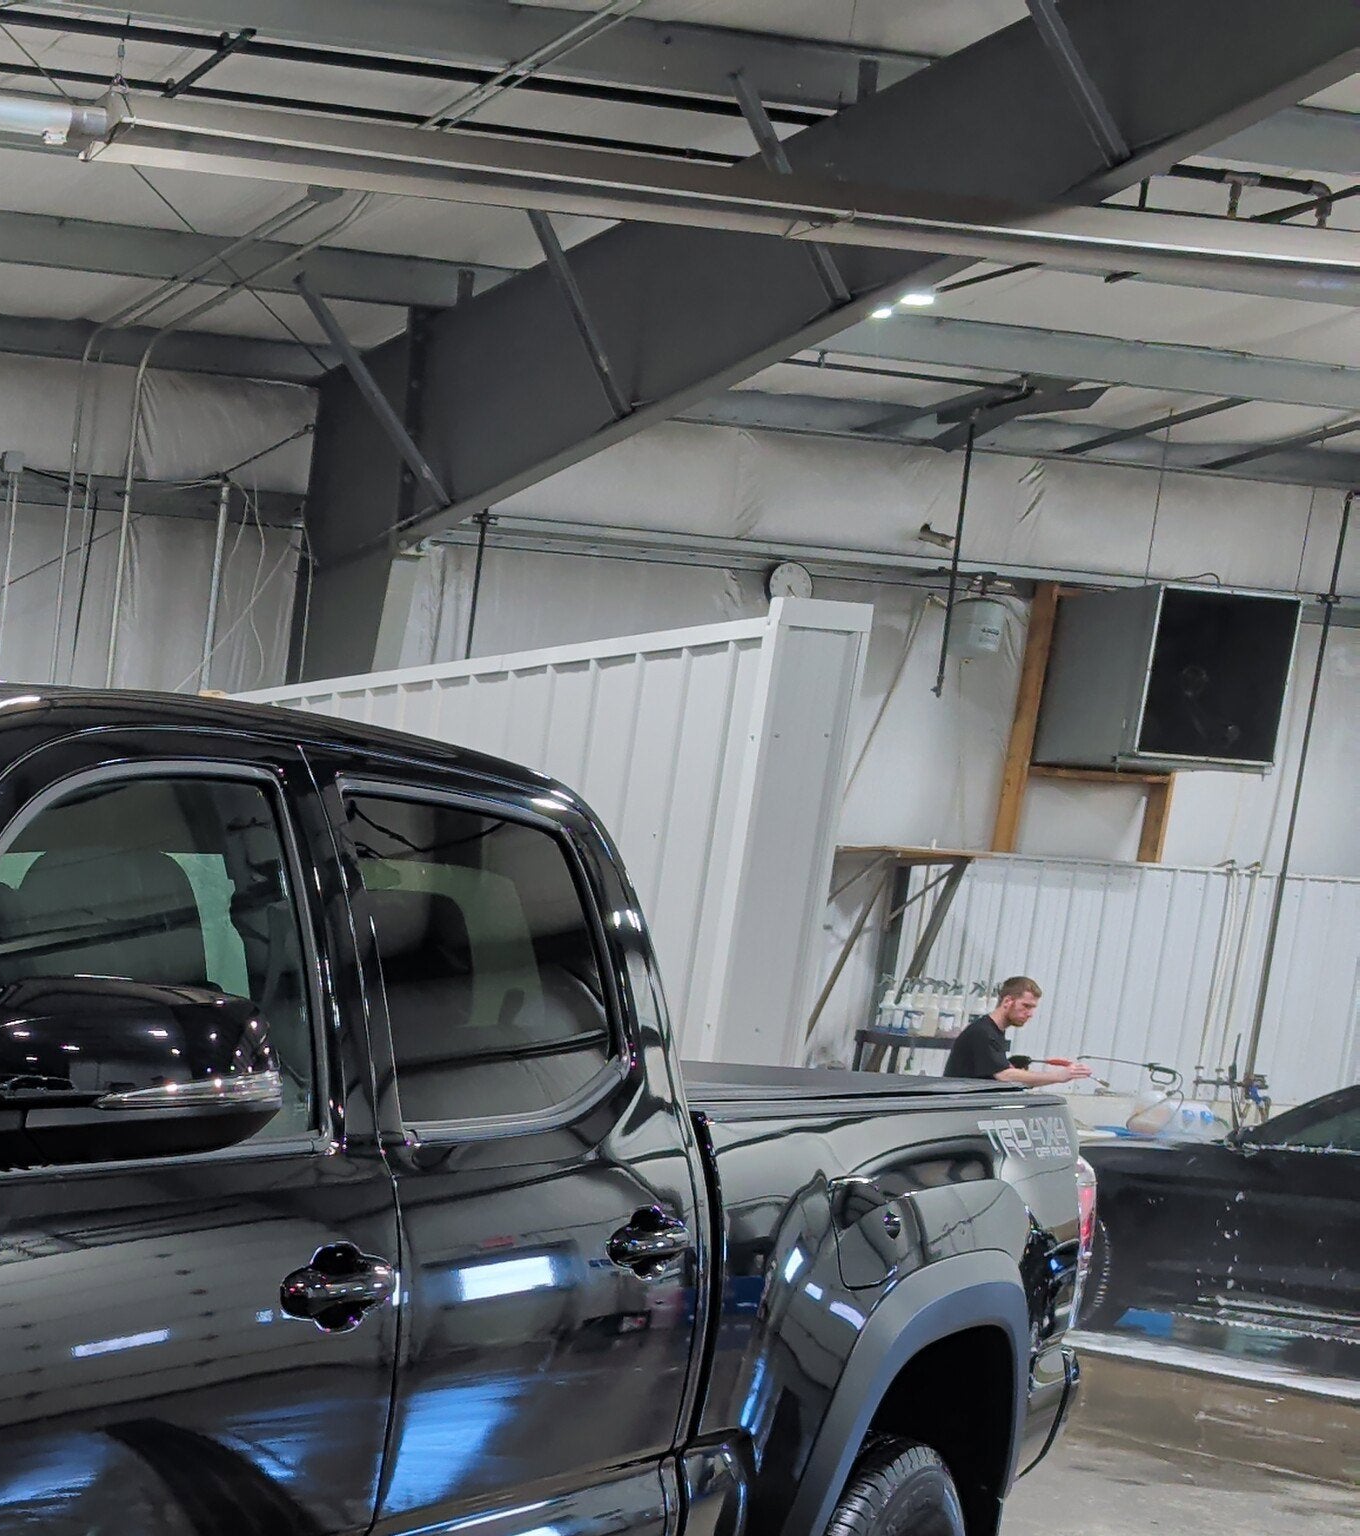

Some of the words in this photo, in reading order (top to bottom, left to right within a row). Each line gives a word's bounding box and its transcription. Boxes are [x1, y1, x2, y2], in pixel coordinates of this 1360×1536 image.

[977, 1119, 1033, 1160] TRD
[1035, 1147, 1051, 1157] OFF
[1051, 1146, 1072, 1157] ROAD
